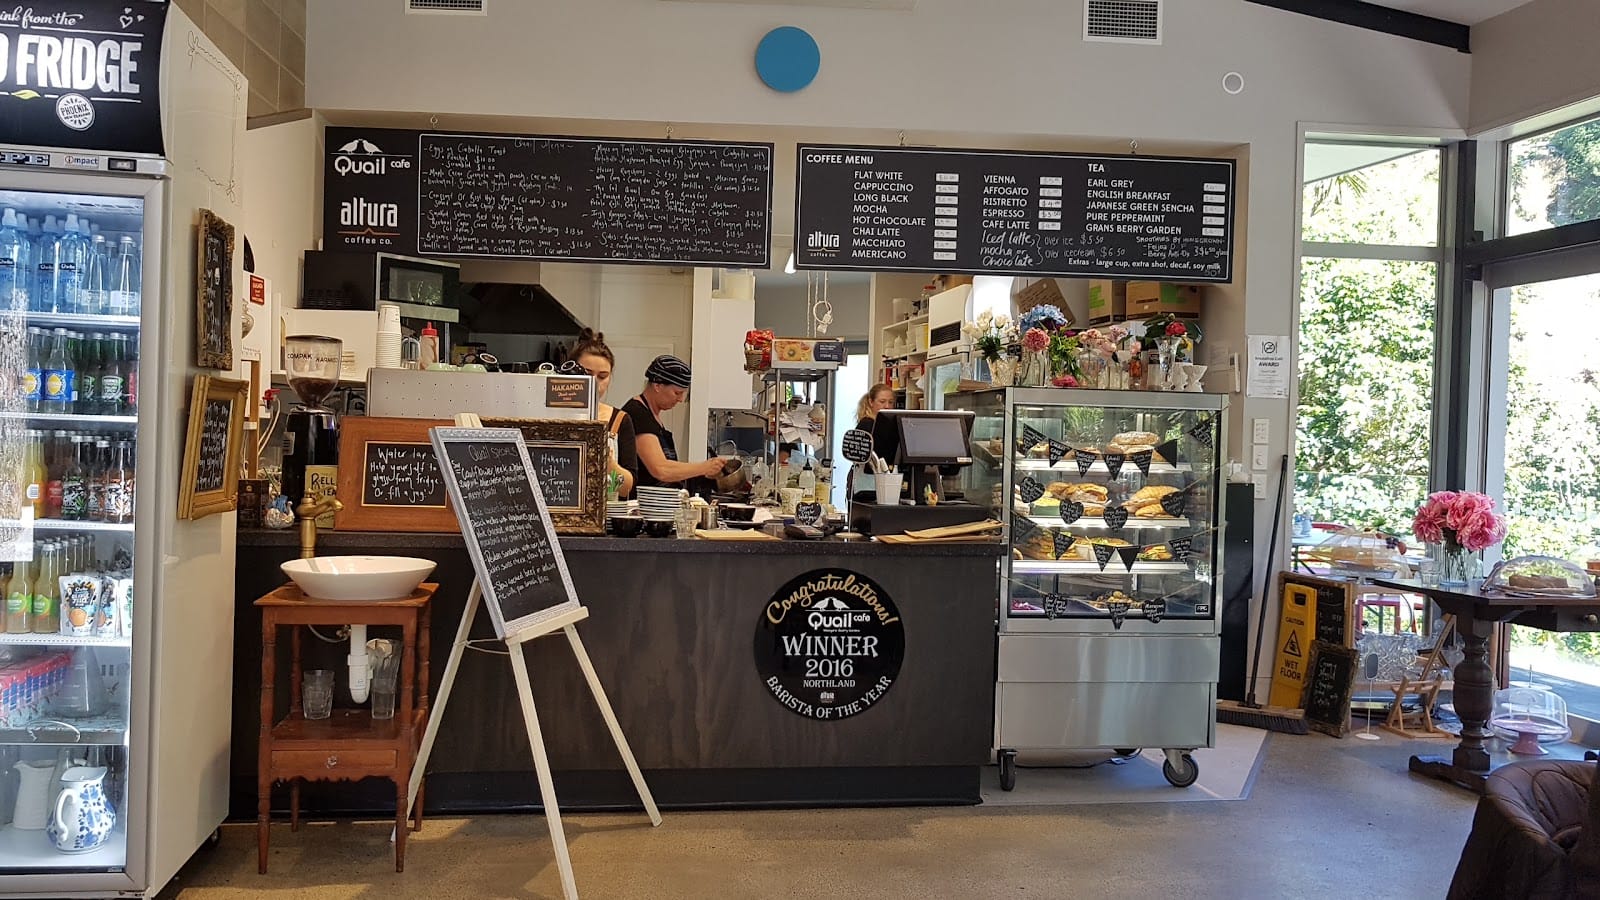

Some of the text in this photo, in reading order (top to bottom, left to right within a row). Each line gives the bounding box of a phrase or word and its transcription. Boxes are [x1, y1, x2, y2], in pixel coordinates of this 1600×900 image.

[22, 8, 53, 29] from
[52, 12, 84, 26] the
[16, 34, 142, 93] FRIDGE
[60, 103, 89, 116] PHOENIX
[806, 154, 874, 165] COFFEE MENU
[334, 155, 411, 177] Quail cafe
[1088, 163, 1105, 173] TEA
[854, 171, 904, 181] FLAT WHITE
[983, 175, 1016, 184] VIENNA
[853, 182, 914, 192] CAPPUCCINO
[1087, 179, 1134, 188] EARL GREY
[983, 186, 1029, 196] AFFOGATO
[1087, 190, 1171, 201] ENGLISH BREAKFAST
[853, 193, 909, 203] LONG BLACK
[983, 198, 1028, 207] RISTRETTO
[340, 197, 398, 228] altura
[853, 205, 888, 214] MOCHA
[1086, 201, 1195, 213] JAPANESE GREEN SENCHA
[982, 209, 1025, 218] ESPRESSO
[1086, 212, 1166, 223] PURE PEPPERMINT
[852, 216, 926, 226] HOT CHOCOLATE
[982, 220, 1004, 229] CAFE
[1007, 221, 1030, 230] LATTE
[852, 227, 900, 237] CHAI LATTE
[1086, 223, 1182, 235] GRANS BERRY GARDEN
[344, 236, 393, 245] coffee co.
[808, 231, 840, 248] altura
[852, 238, 906, 248] MACCHIATO
[981, 230, 1006, 245] Iced
[851, 249, 907, 259] AMERICANO
[980, 246, 1013, 257] mocha
[1068, 258, 1090, 266] Extras
[1096, 258, 1114, 269] large
[1115, 261, 1131, 269] cup,
[1151, 260, 1169, 269] shot,
[1170, 261, 1191, 270] decaf,
[1193, 263, 1206, 271] soy
[551, 383, 584, 391] HAKANOA
[377, 447, 408, 464] Water
[370, 461, 386, 473] Help
[766, 573, 899, 626] Congratulations!
[808, 612, 871, 630] Quail cafe
[1285, 616, 1304, 626] CAUTION
[781, 632, 878, 658] WINNER
[805, 659, 853, 677] 2016
[1284, 658, 1299, 670] WET
[1280, 667, 1302, 681] FLOOR
[803, 679, 856, 688] NORTHLAND
[766, 675, 892, 718] BARISTA OF THE YEAR
